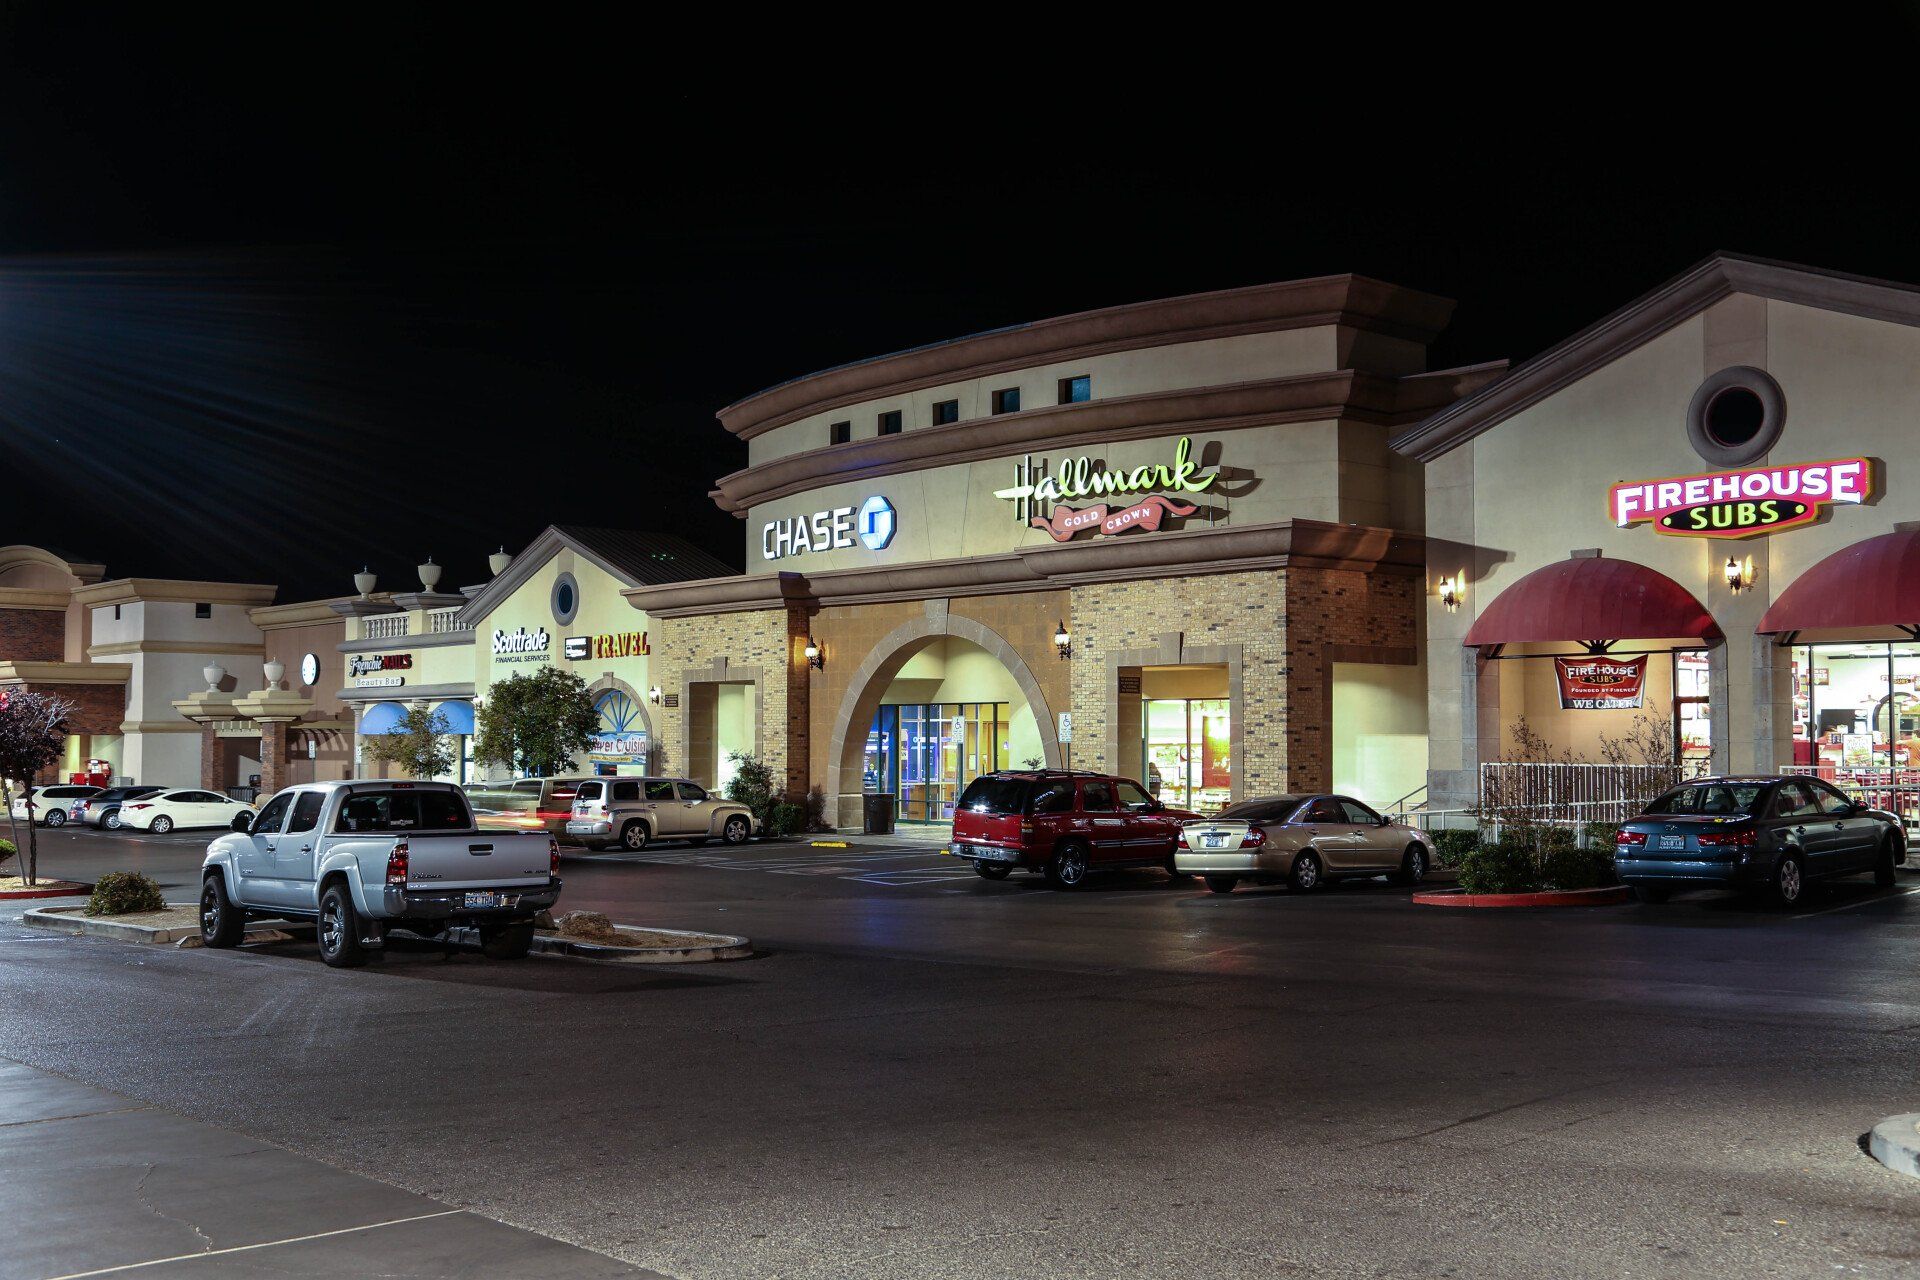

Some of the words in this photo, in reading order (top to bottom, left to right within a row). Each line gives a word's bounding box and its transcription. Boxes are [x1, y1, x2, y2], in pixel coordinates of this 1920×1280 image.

[993, 437, 1218, 527] Hallmark
[1617, 462, 1861, 528] FIREHOUSE
[1064, 511, 1099, 527] GOLD
[1106, 508, 1150, 530] CROWN
[1690, 500, 1779, 530] SUBS
[763, 507, 856, 560] CHASE
[492, 627, 549, 653] Scottrade
[593, 632, 650, 658] TRAVEL
[524, 654, 551, 662] SERVICES
[356, 679, 383, 687] Beauty
[385, 678, 401, 687] Bar
[1567, 666, 1637, 679] FIREHOUSE
[1589, 675, 1615, 683] SUBS
[1572, 699, 1594, 709] WE
[1595, 699, 1634, 709] CATER
